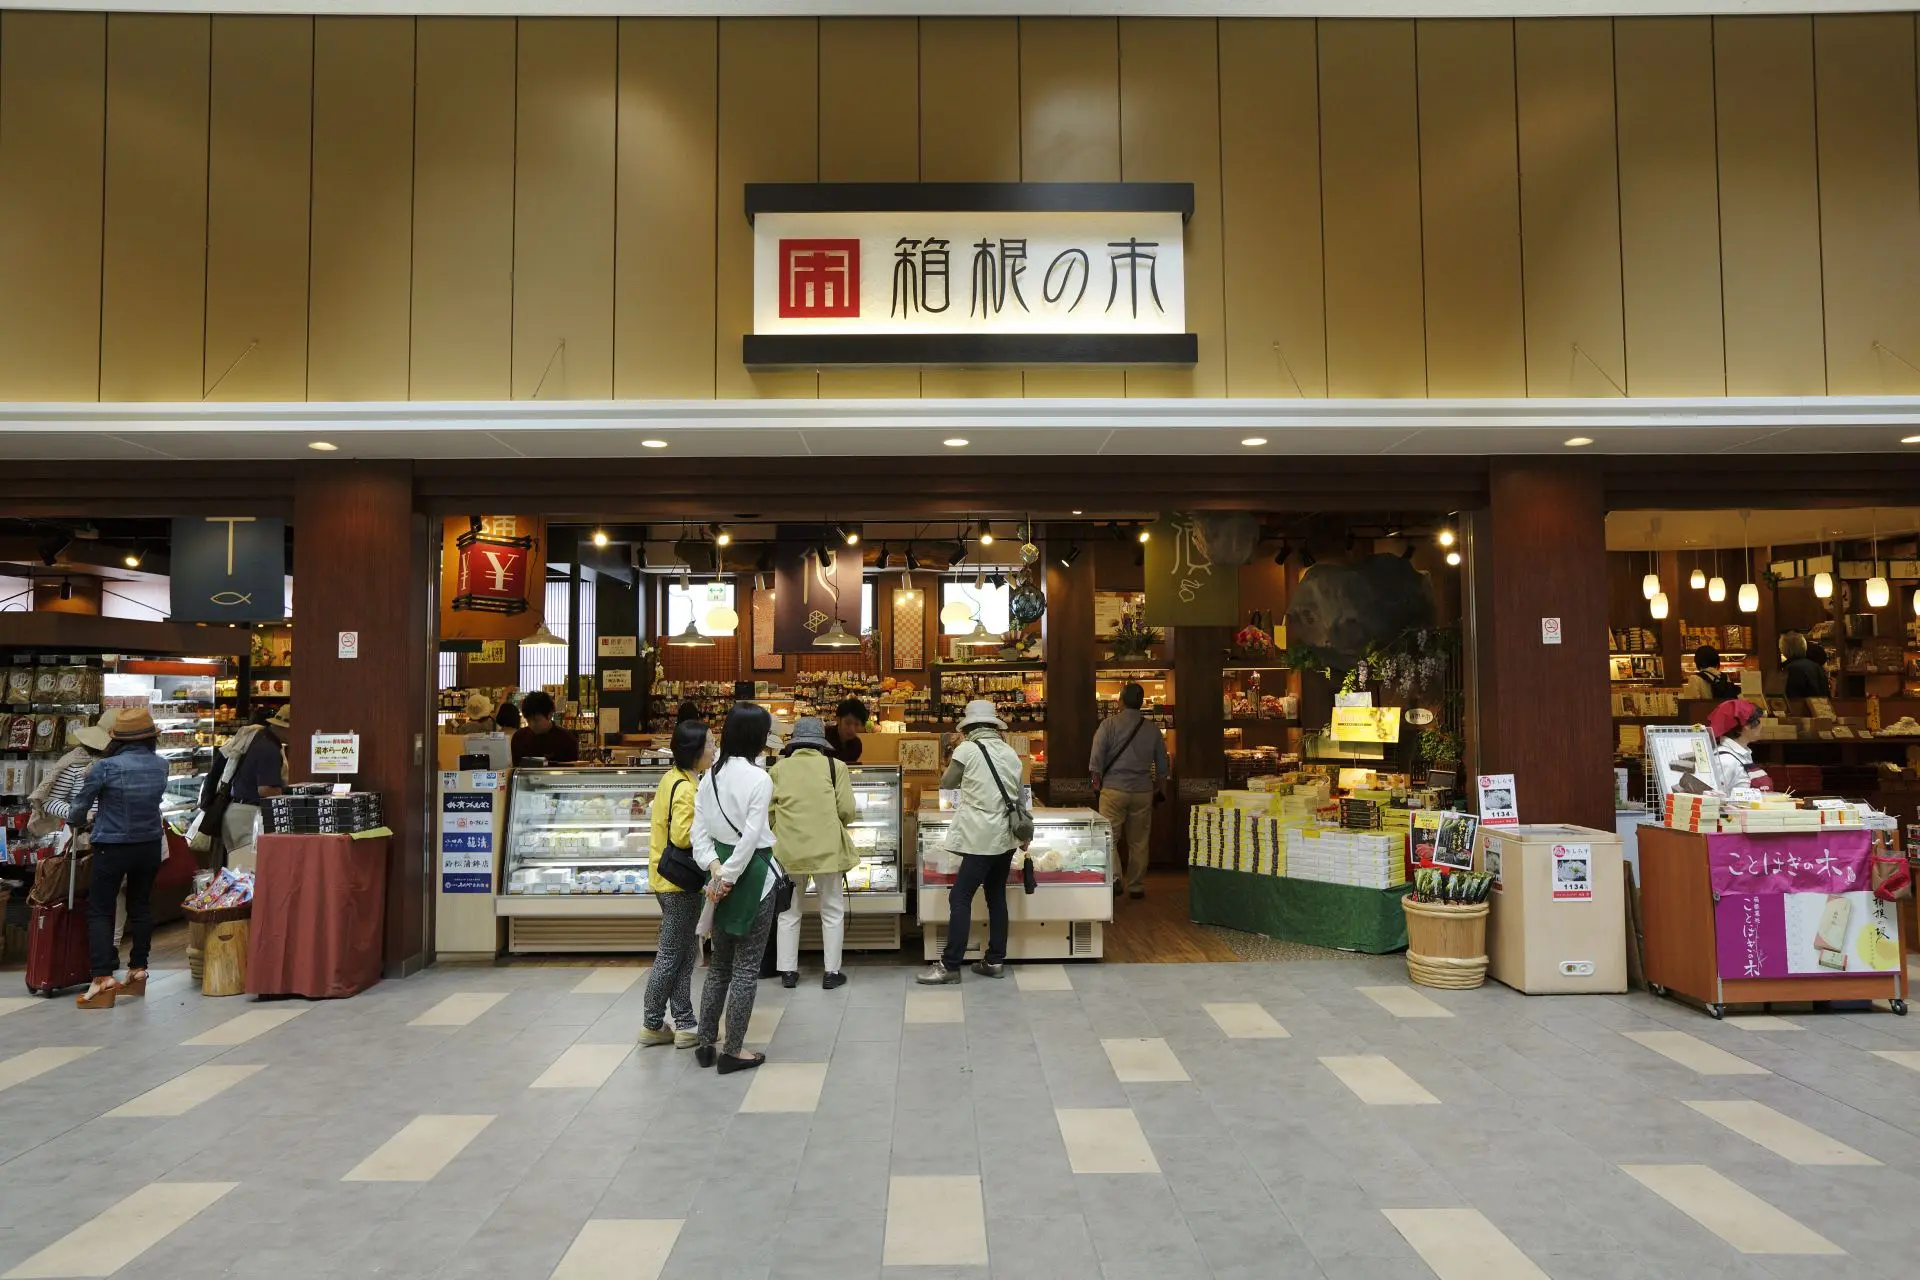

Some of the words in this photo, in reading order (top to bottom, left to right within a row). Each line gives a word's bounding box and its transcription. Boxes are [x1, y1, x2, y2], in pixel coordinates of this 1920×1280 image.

[891, 236, 1165, 320] 箱根の市
[314, 746, 355, 755] 湯本らーめん
[1728, 848, 1843, 878] ことほぎの木
[1742, 897, 1761, 977] ことほぎの木
